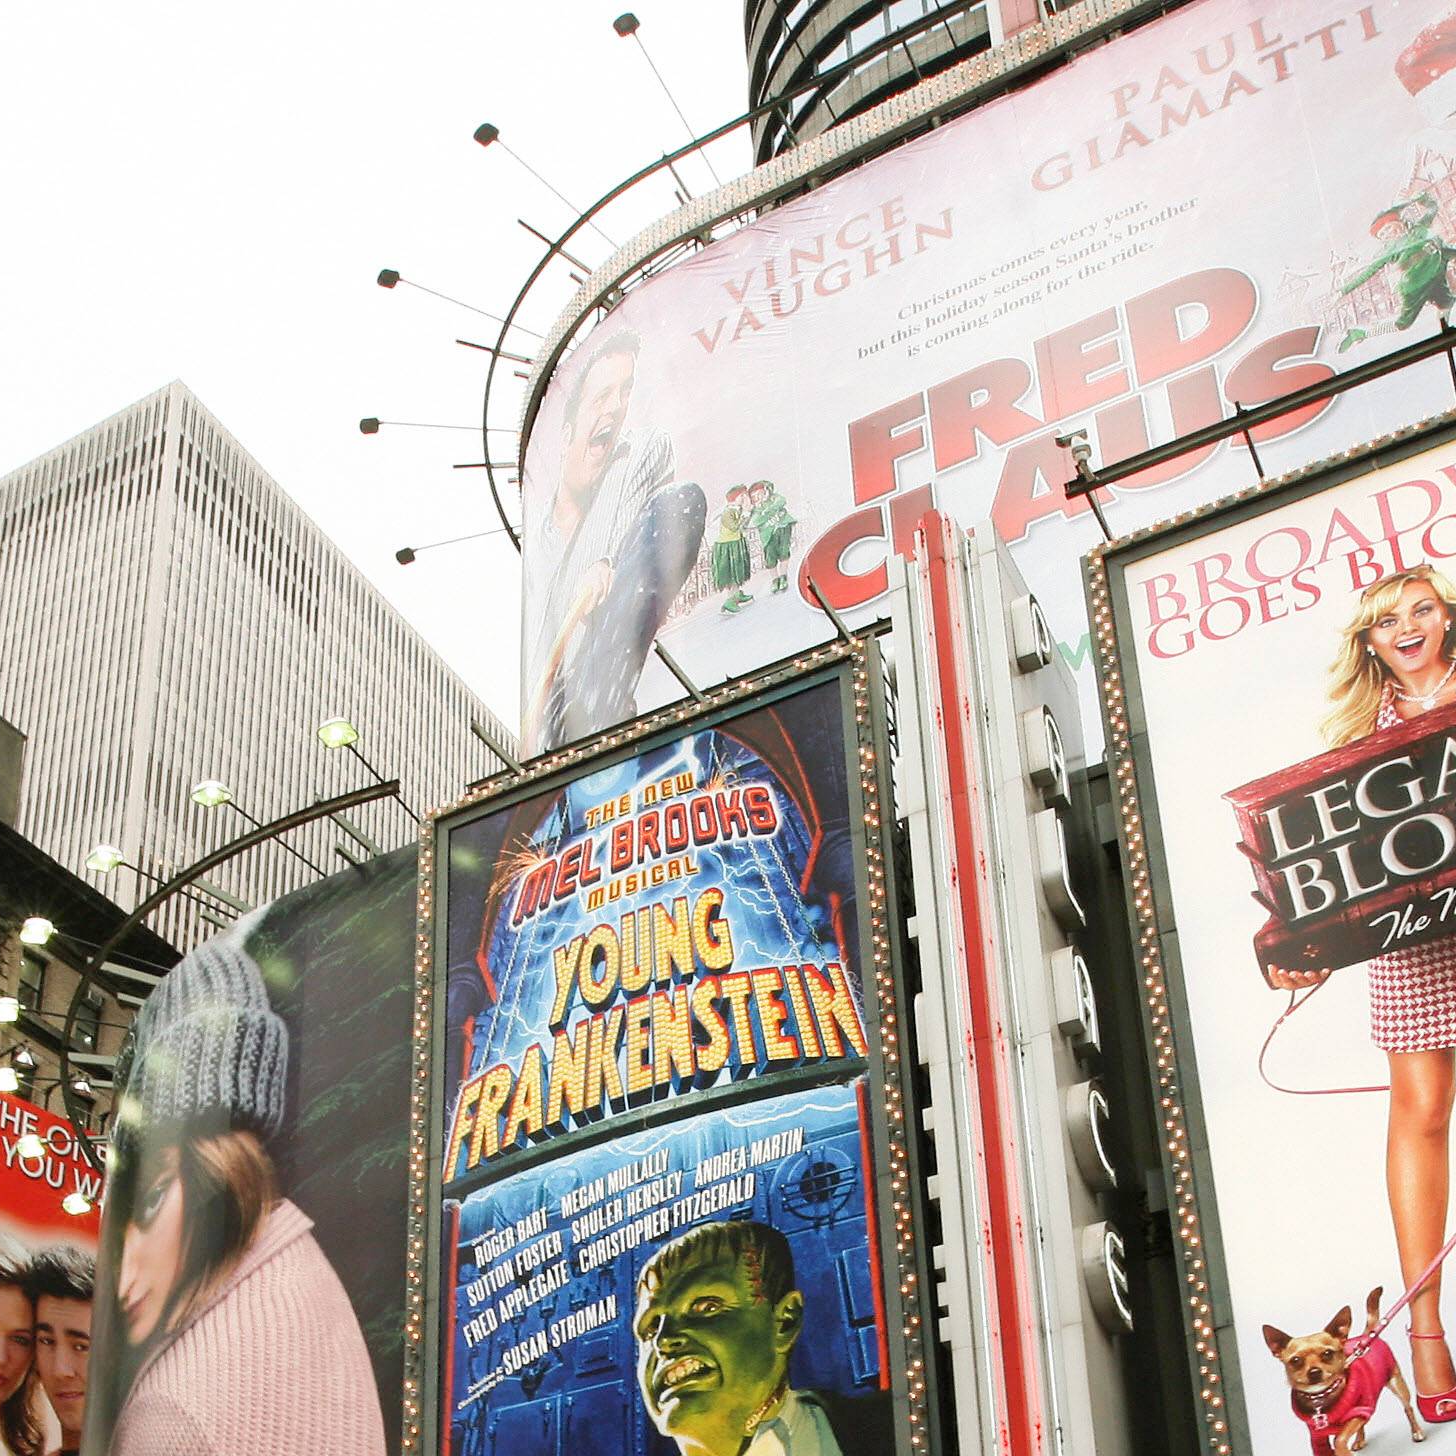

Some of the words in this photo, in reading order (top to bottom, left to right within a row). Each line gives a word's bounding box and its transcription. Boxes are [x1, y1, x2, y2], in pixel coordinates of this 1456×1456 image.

[1030, 8, 1384, 193] GIAMATTI
[1109, 18, 1280, 122] PAUL
[692, 211, 956, 354] VAUGHN
[720, 195, 914, 304] VINCE
[891, 322, 922, 346] this
[925, 293, 990, 332] holiday
[993, 265, 1051, 297] season
[1056, 231, 1123, 272] Santa's
[1127, 195, 1200, 238] brother
[898, 272, 988, 321] Christmas
[847, 267, 1260, 503] FRED
[798, 326, 1340, 612] CLAUS
[1147, 565, 1322, 659] GOES
[586, 799, 632, 830] THE
[643, 772, 696, 806] NEW
[511, 840, 606, 929] MEL
[611, 786, 779, 872] BROOKS
[587, 854, 701, 913] MUSICAL
[549, 887, 736, 1037] YOUNG
[1369, 910, 1432, 949] The
[443, 962, 869, 1185] FRANKENSTEIN
[3, 1137, 66, 1189] YOU
[560, 1175, 607, 1219] MEGAN
[607, 1148, 670, 1190] MULLALLY
[571, 1201, 624, 1245] SHULER
[626, 1171, 683, 1217] HENSLEY
[466, 1262, 516, 1307] SUTTON
[517, 1231, 563, 1276] FOSTER
[474, 1231, 516, 1269] ROGER
[517, 1207, 547, 1240] BART
[578, 1212, 672, 1274] CHRISTOPHER
[672, 1173, 757, 1228] FITZGERALD
[463, 1308, 499, 1348] FRED
[501, 1259, 570, 1322] APPLEGATE
[502, 1330, 549, 1376] SUSAN
[551, 1294, 617, 1348] STROMAN
